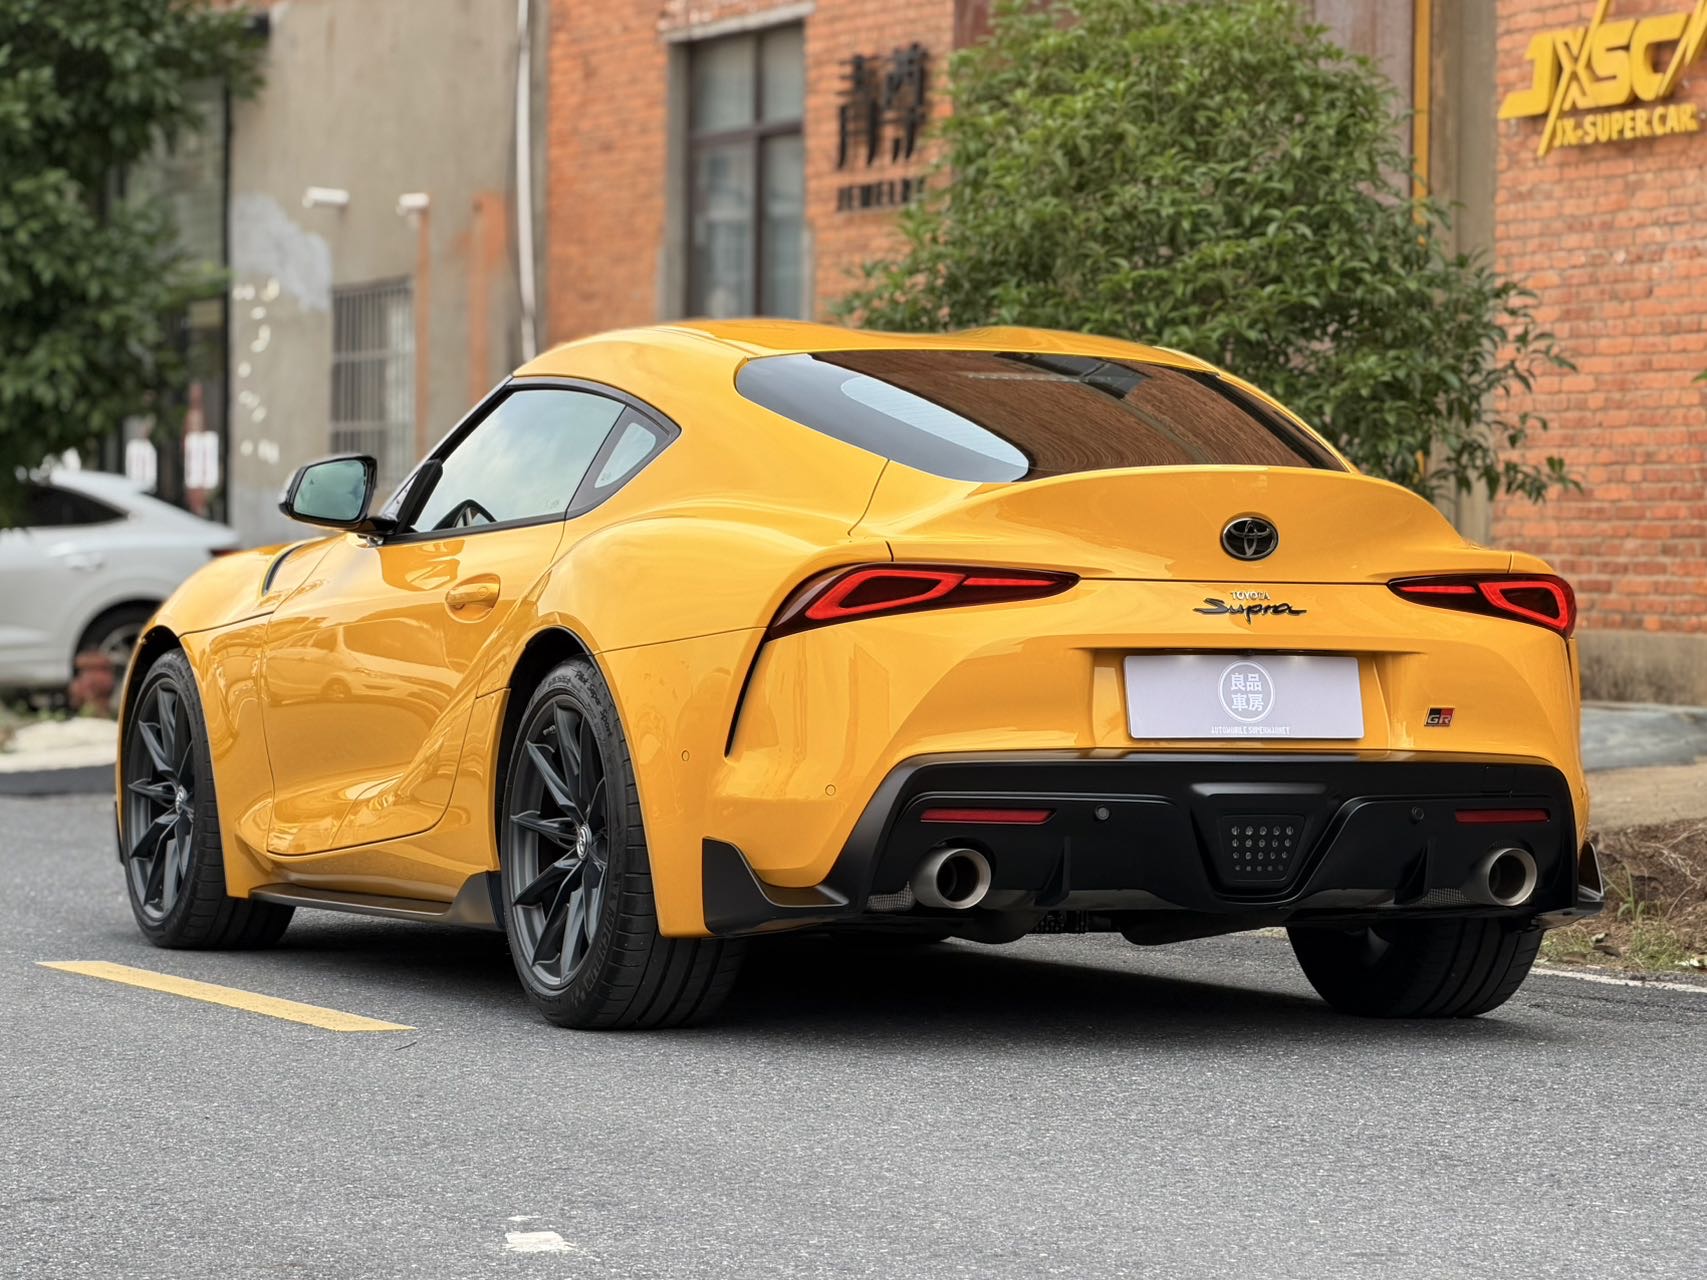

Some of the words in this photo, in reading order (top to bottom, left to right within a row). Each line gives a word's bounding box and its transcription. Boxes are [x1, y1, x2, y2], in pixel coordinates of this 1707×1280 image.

[1652, 103, 1698, 136] CAR
[1231, 591, 1270, 600] TOYOTA
[1193, 598, 1306, 624] Supra
[1231, 672, 1262, 691] 良品
[1231, 693, 1264, 711] 車房
[600, 710, 613, 737] Sport
[1427, 714, 1451, 724] GR
